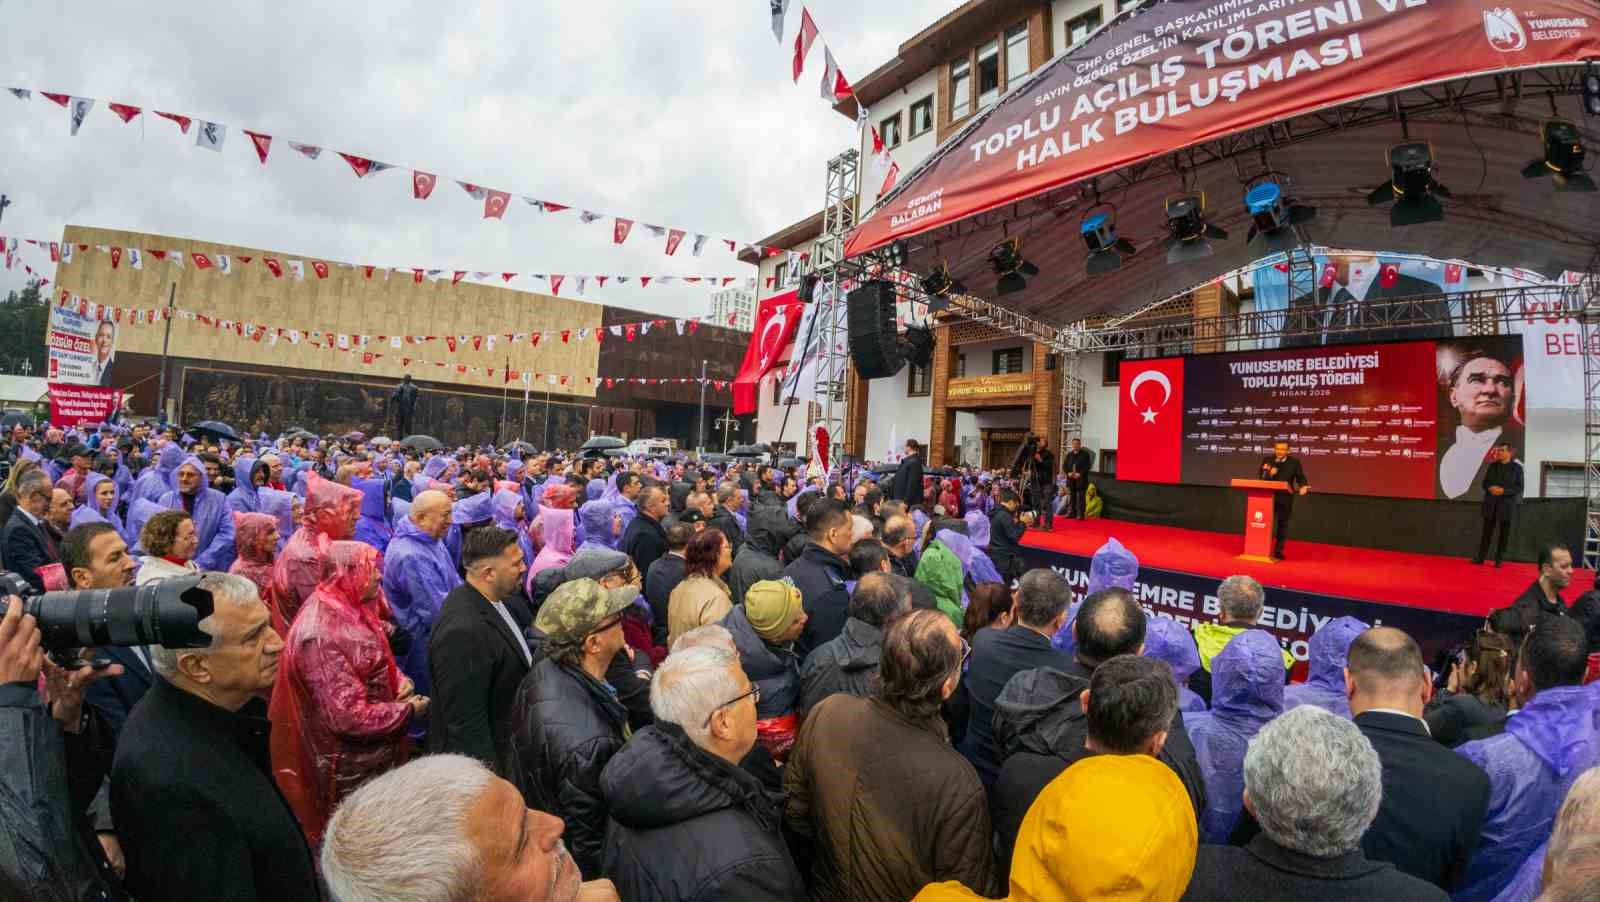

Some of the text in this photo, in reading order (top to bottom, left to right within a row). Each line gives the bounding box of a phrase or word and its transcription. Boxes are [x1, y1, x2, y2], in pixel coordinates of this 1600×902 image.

[1076, 56, 1103, 74] CHP
[1105, 35, 1151, 60] GENEL
[1016, 33, 1364, 171] HALK BULUŞMASI
[1034, 83, 1071, 106] SAYIN
[1073, 62, 1119, 88] ÖZGÜR
[970, 105, 1061, 162] TOPLU
[1069, 55, 1186, 122] AÇILIŞ
[890, 199, 942, 228] BALABAN
[1229, 351, 1379, 375] YUNUSEMRE BELEDİYESİ
[1242, 369, 1364, 389] TOPLU AÇILIŞ TÖRENİ
